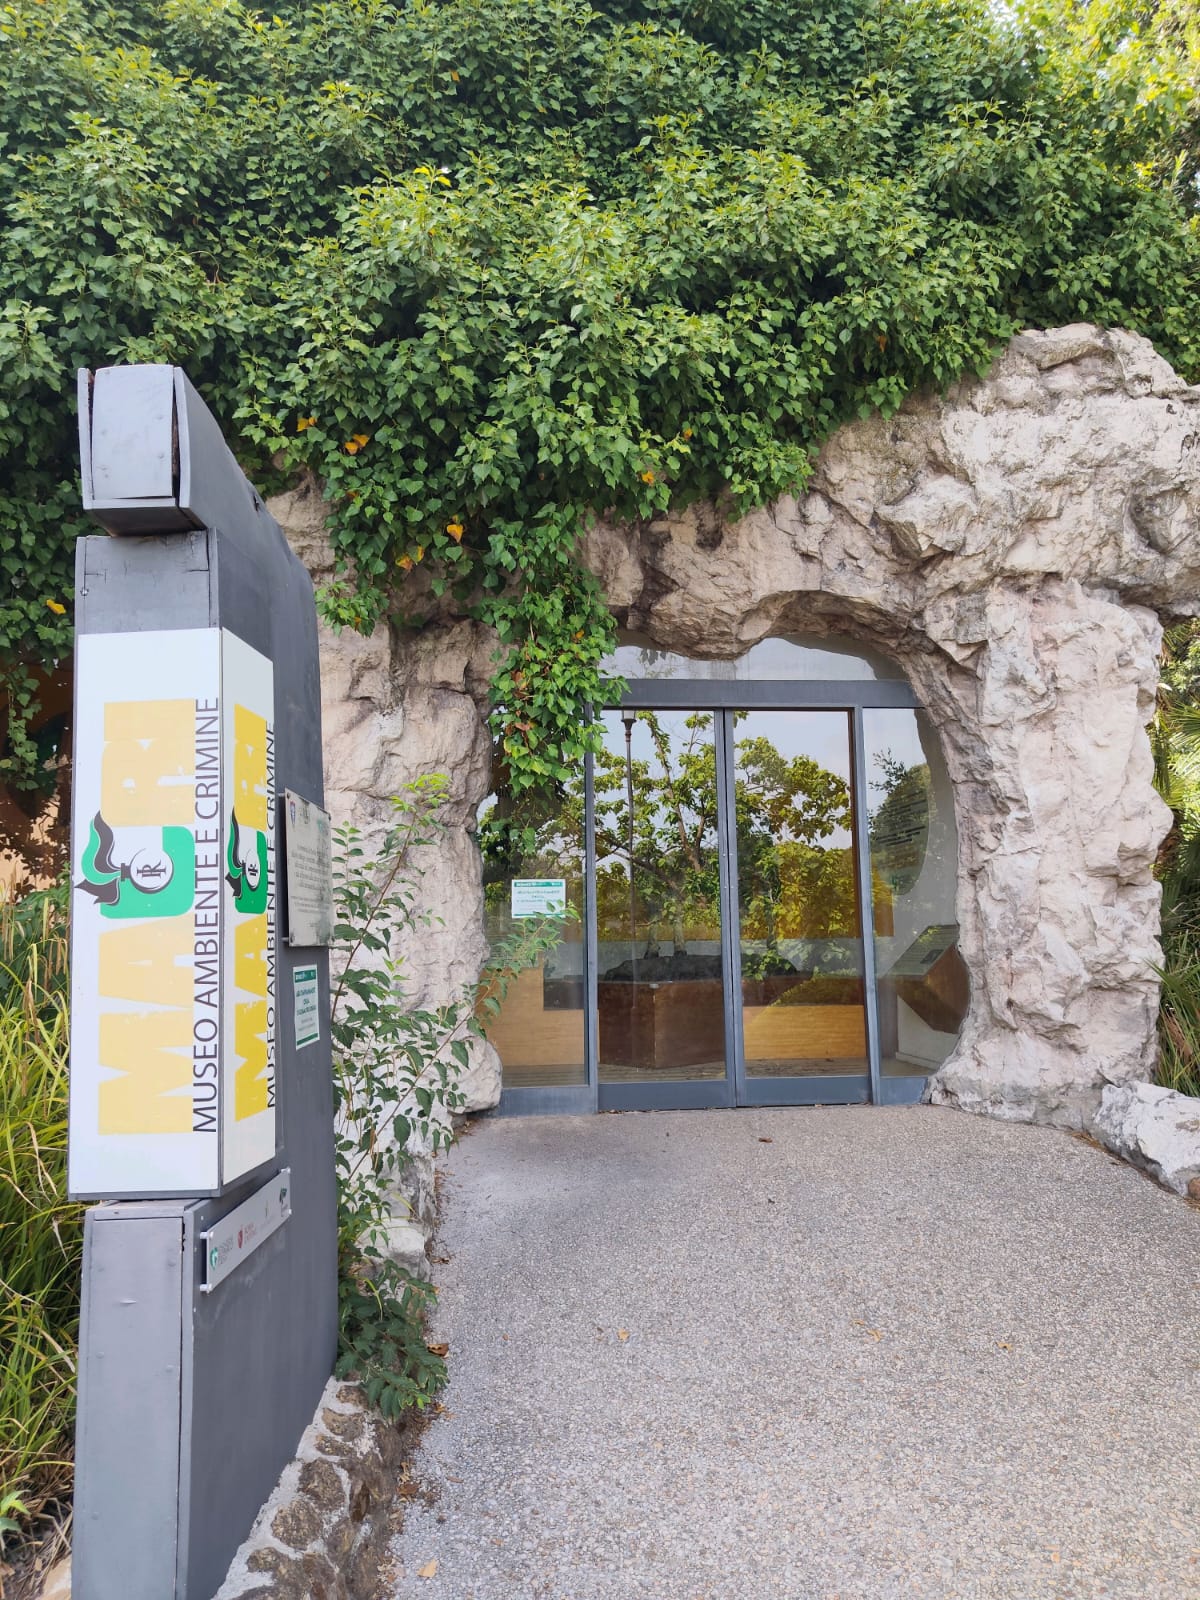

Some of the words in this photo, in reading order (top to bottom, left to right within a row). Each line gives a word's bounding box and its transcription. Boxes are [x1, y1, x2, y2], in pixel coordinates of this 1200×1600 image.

[194, 697, 219, 820] CRIMINE
[195, 828, 219, 844] E
[194, 853, 218, 1008] AMBIENTE
[193, 1018, 218, 1133] MUSEO
